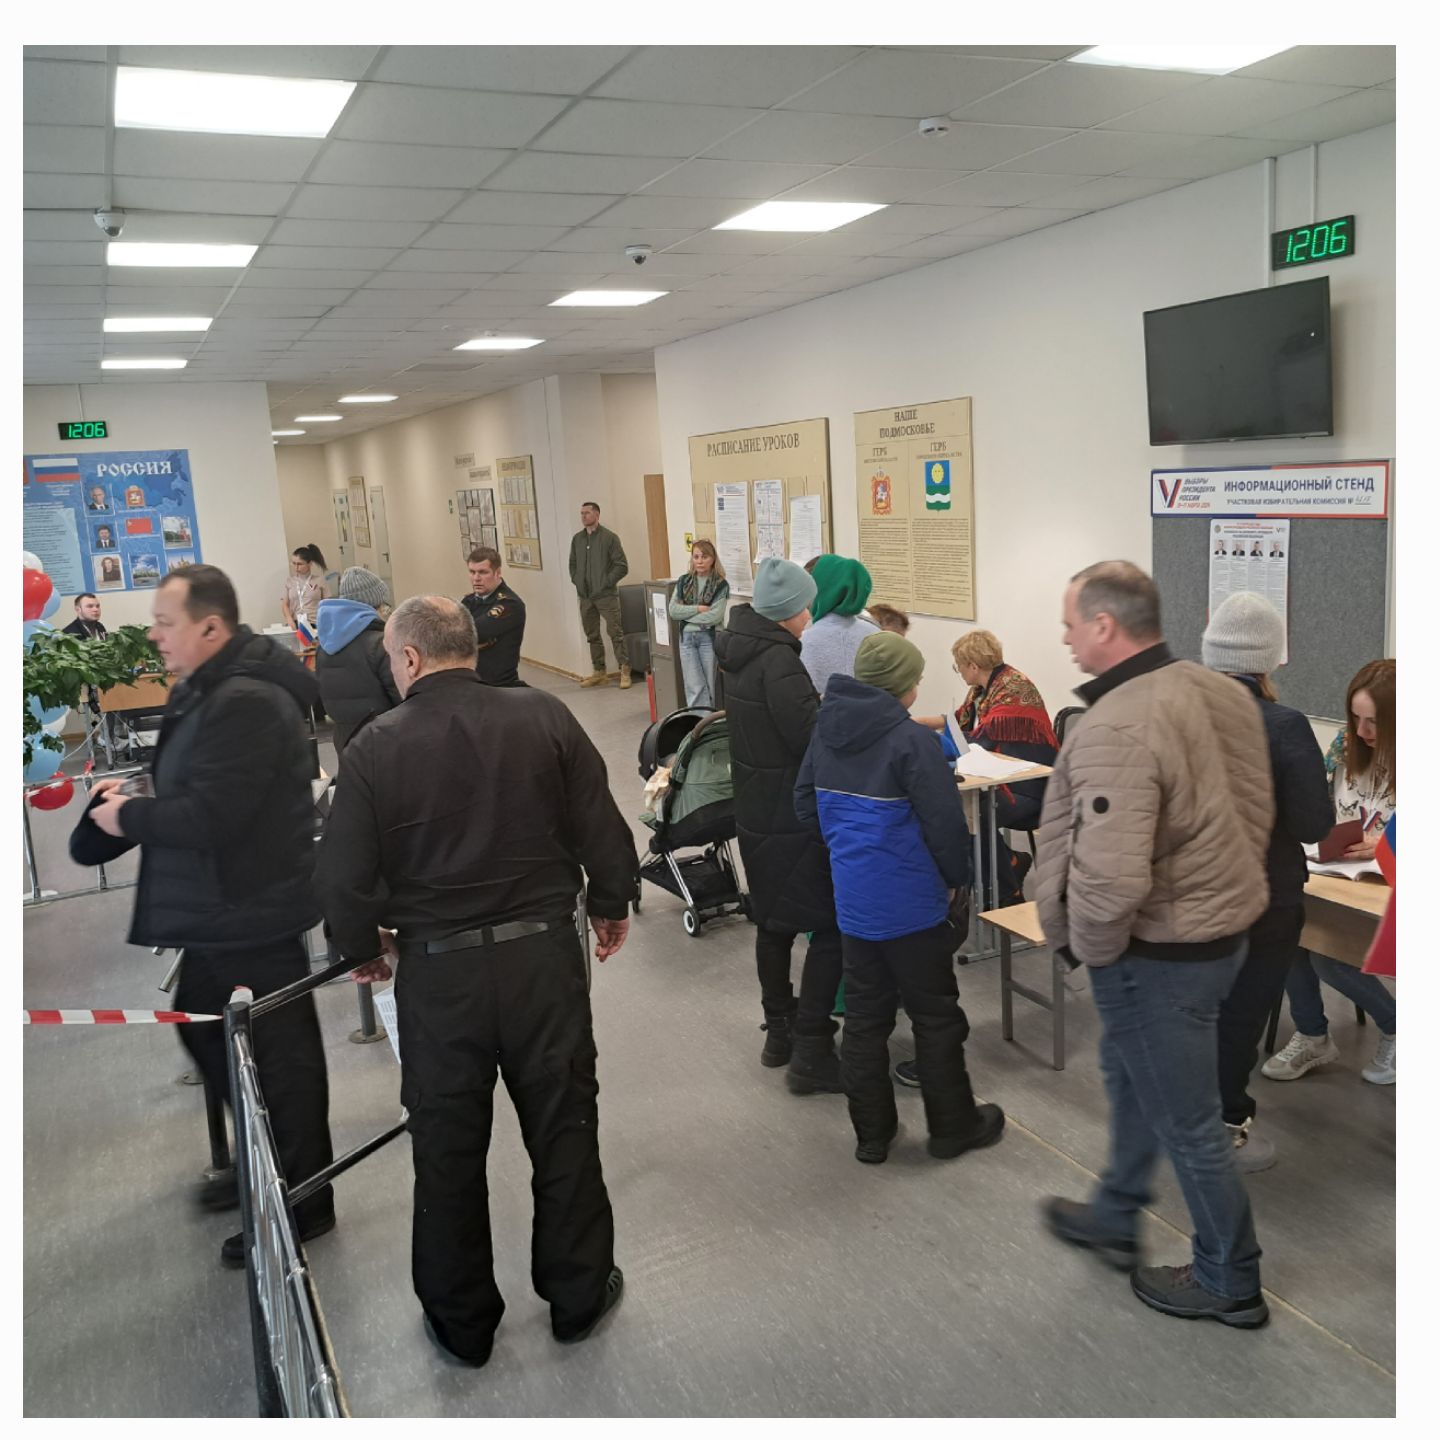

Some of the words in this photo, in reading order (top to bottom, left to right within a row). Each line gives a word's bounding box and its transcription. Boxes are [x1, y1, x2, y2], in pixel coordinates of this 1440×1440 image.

[894, 409, 918, 422] НАШЕ
[68, 422, 105, 438] 1206
[879, 423, 935, 439] ПОДМОСКОВЬЕ
[707, 437, 762, 457] РАСПИСАНИЕ
[762, 432, 800, 451] УРОКОВ
[97, 461, 173, 478] РОССИЯ
[1224, 475, 1333, 493] ИНФОРМАЦИОННЫЙ
[1335, 477, 1375, 492] СТЕНД
